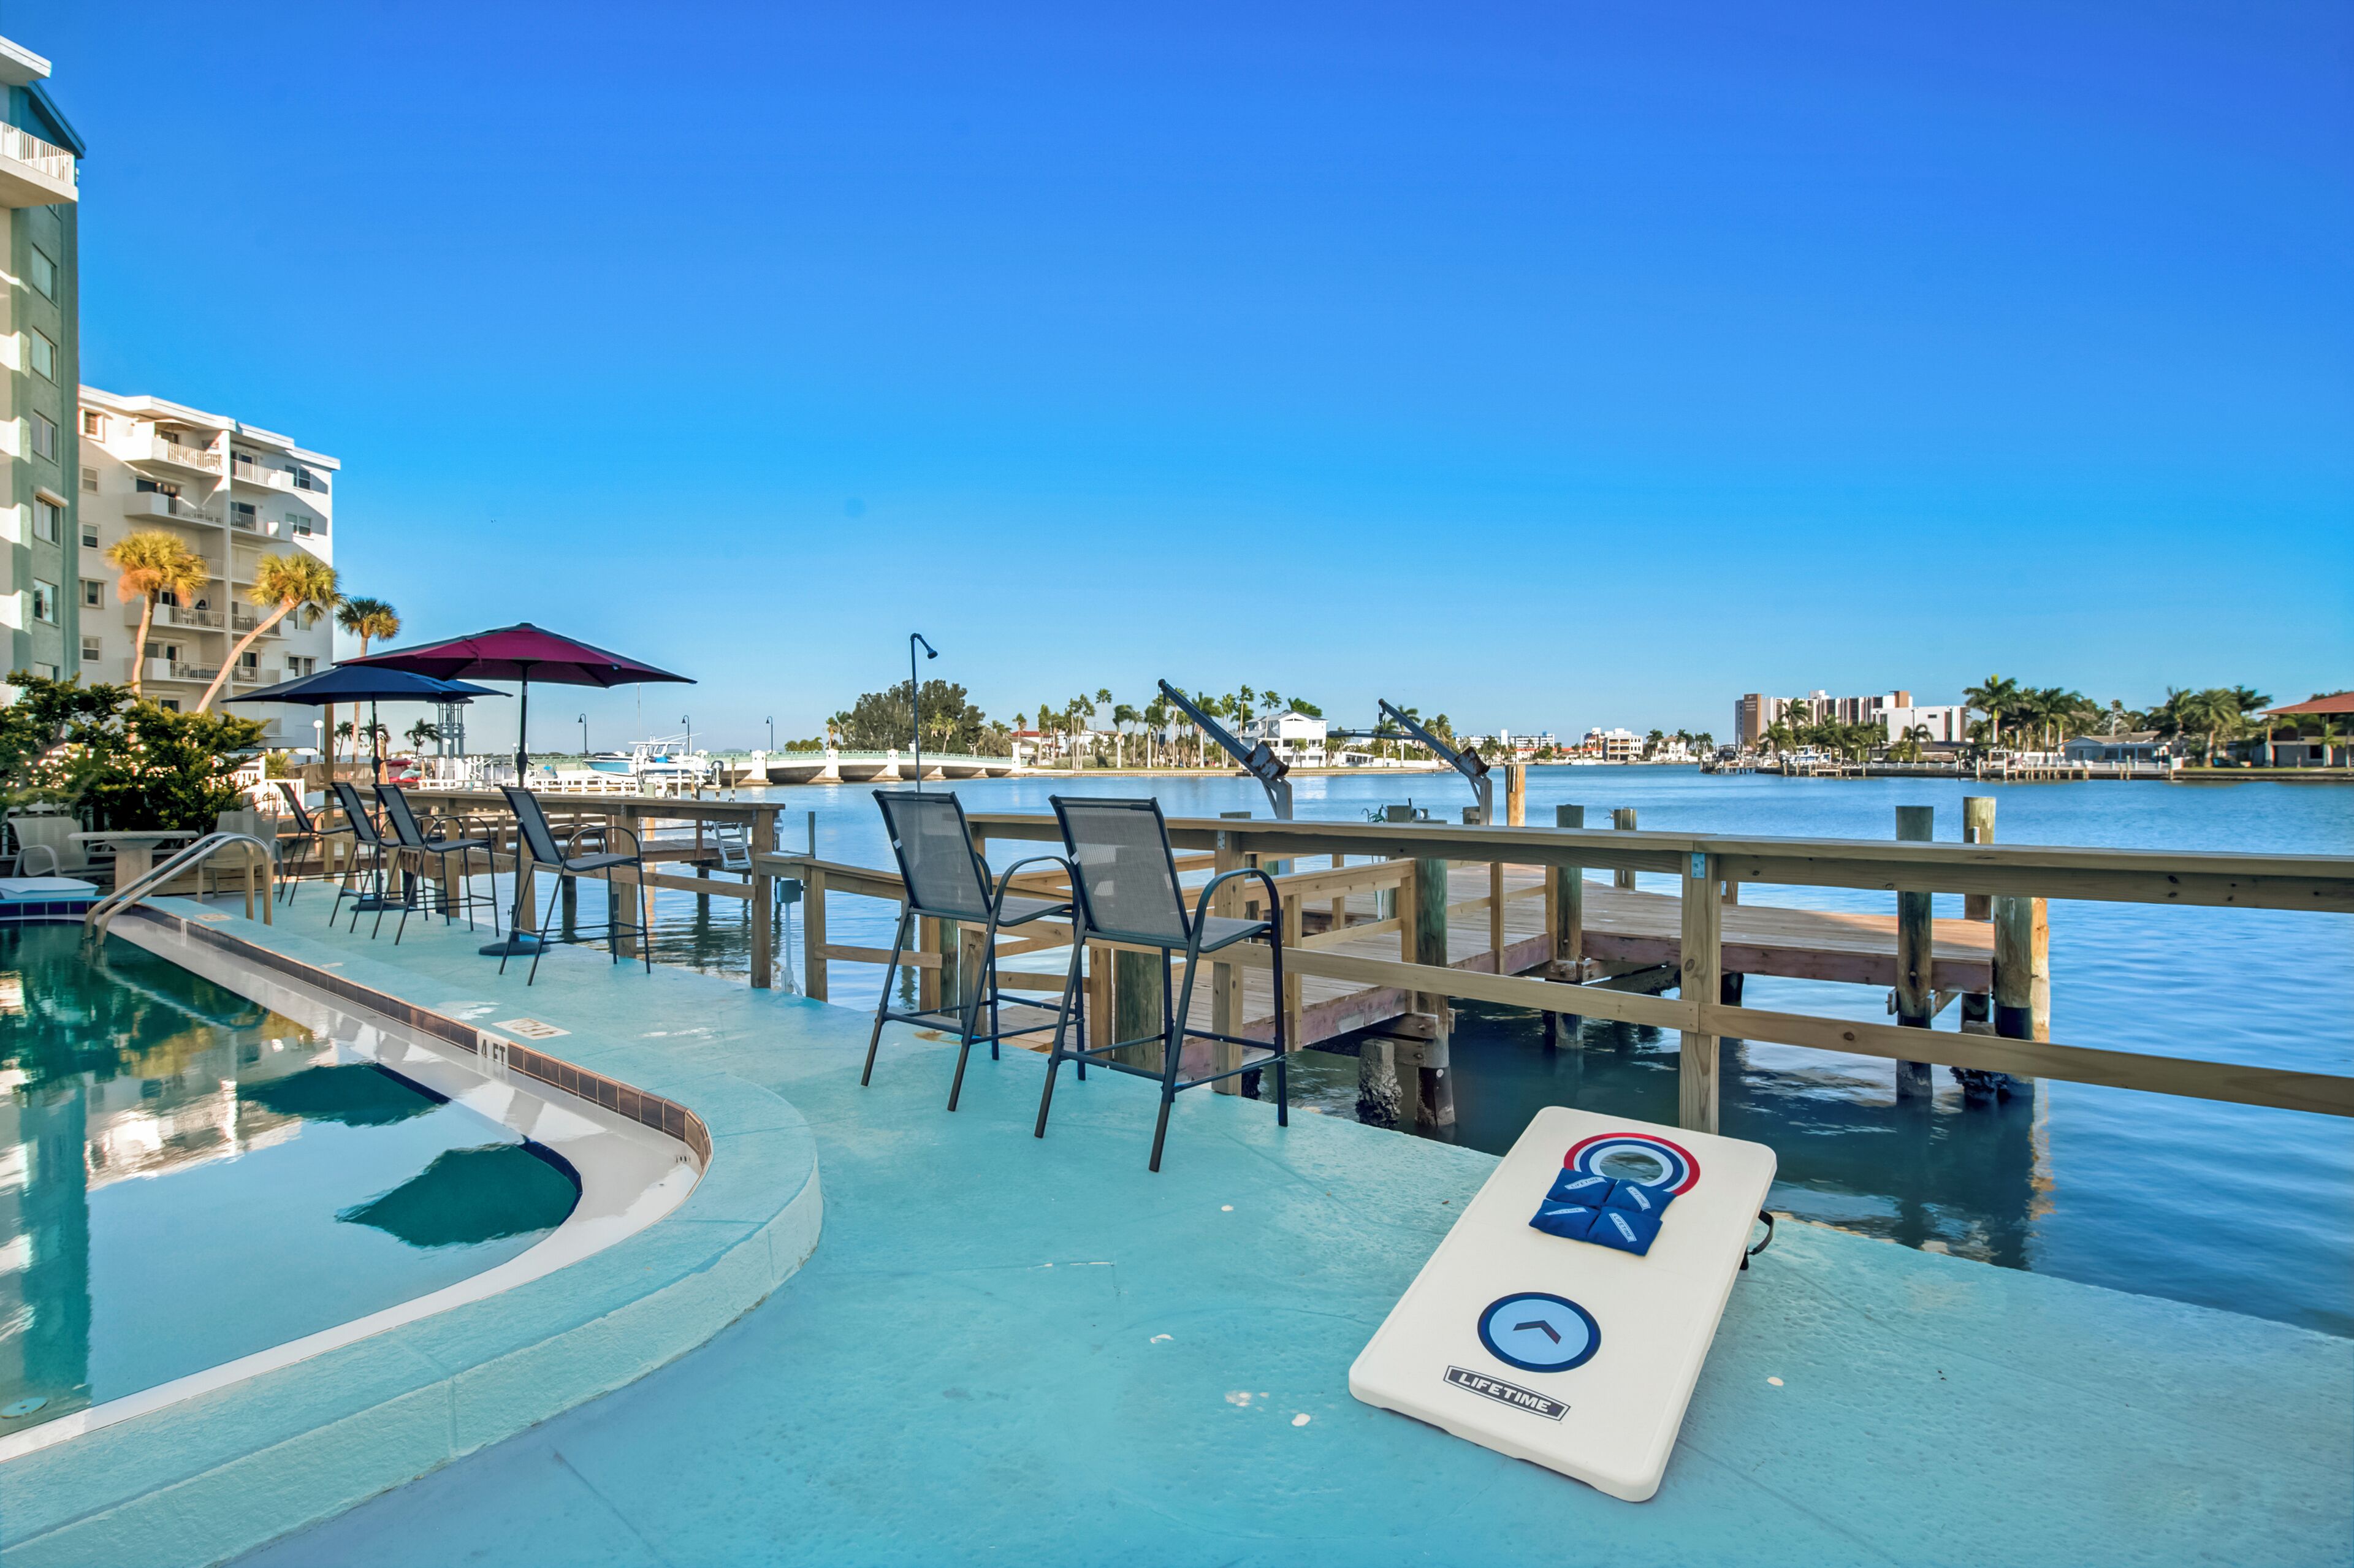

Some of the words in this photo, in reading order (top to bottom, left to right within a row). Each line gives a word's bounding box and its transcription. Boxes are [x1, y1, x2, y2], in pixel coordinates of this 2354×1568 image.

[481, 1039, 487, 1058] 4
[493, 1043, 506, 1064] FT
[1458, 1372, 1552, 1413] LIFETIME
